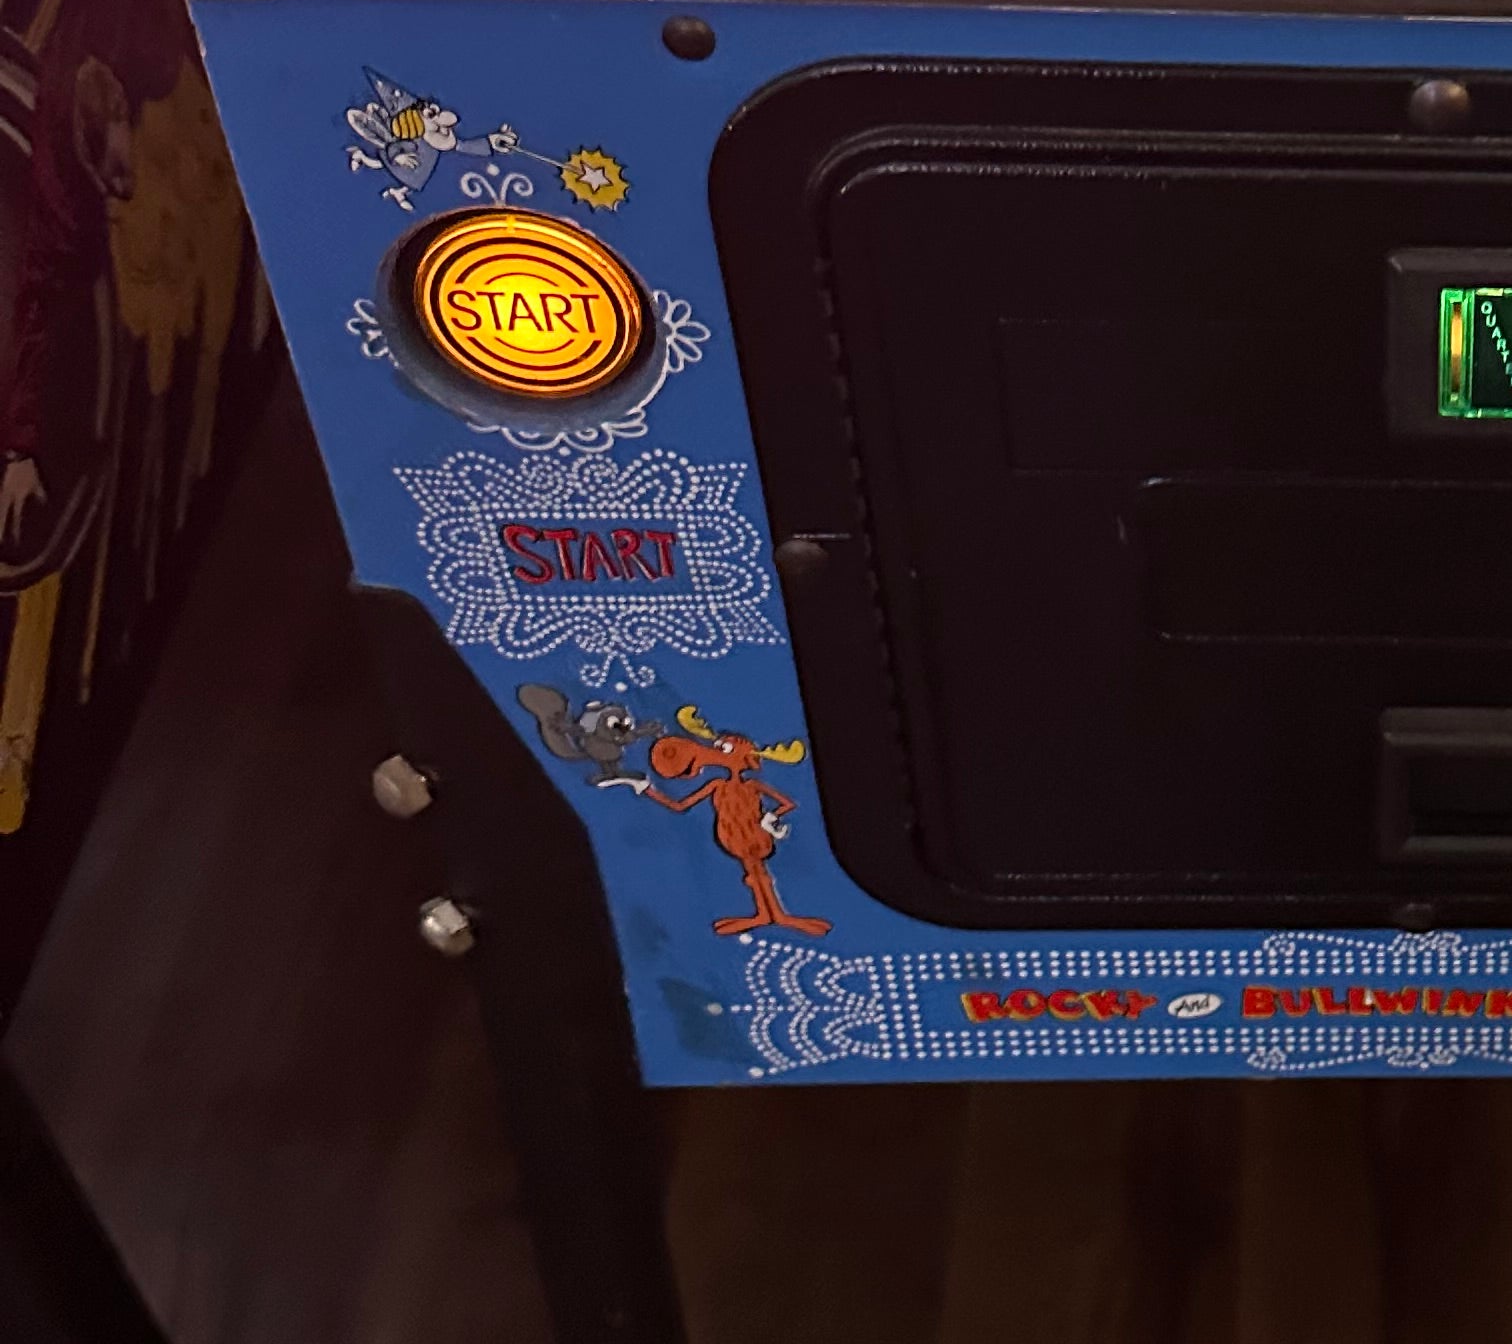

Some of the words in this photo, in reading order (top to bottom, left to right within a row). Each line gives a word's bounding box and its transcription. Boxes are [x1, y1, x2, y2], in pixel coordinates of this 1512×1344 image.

[447, 288, 601, 336] START
[502, 523, 681, 586] START
[960, 989, 1160, 1023] ROCKY
